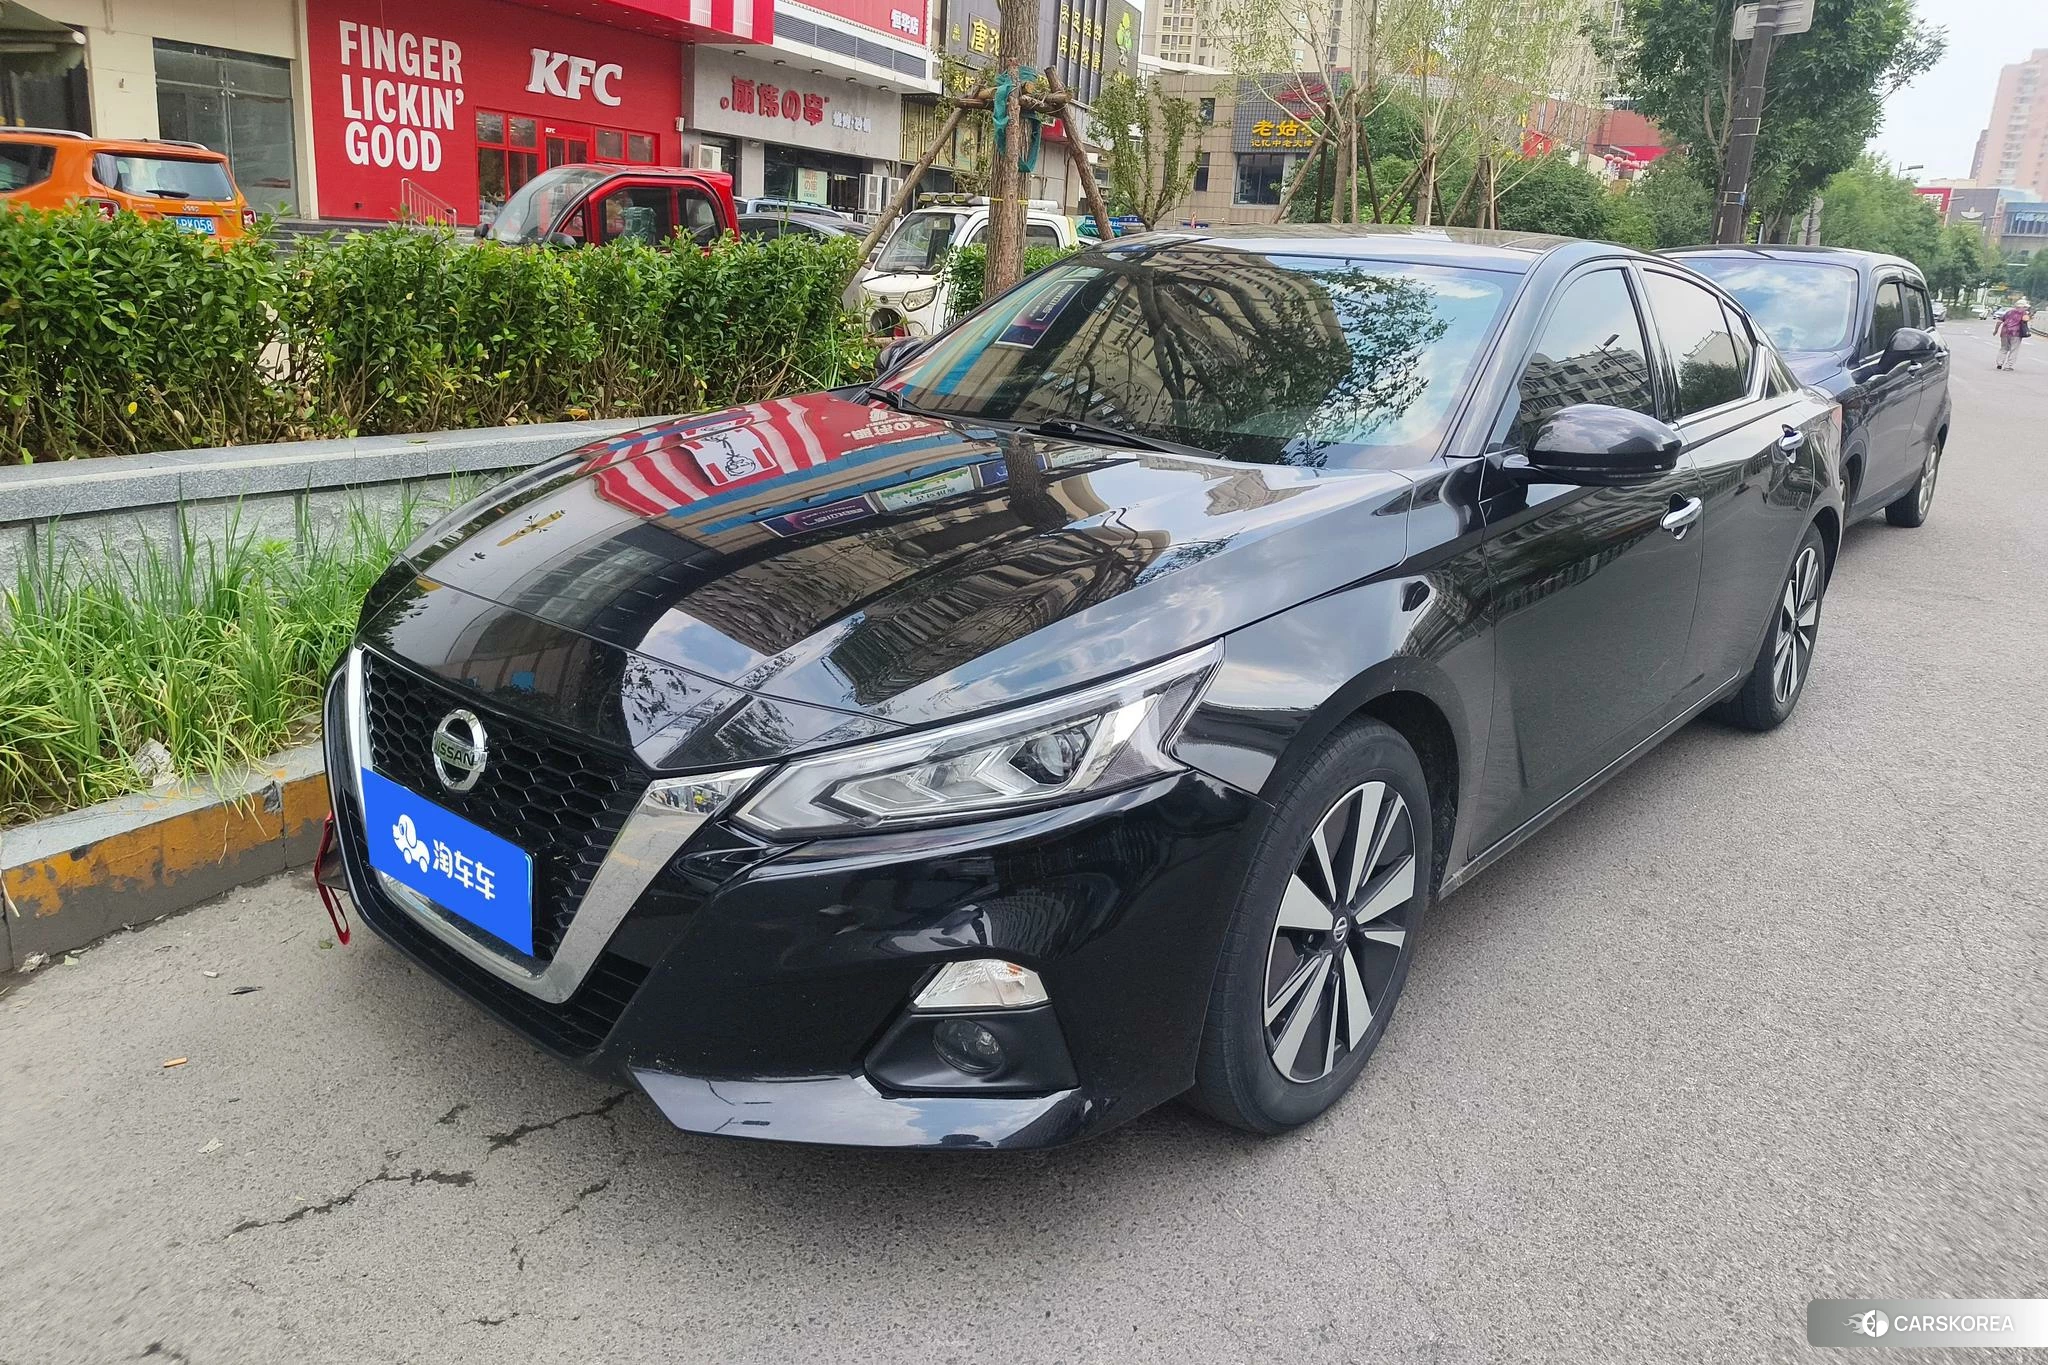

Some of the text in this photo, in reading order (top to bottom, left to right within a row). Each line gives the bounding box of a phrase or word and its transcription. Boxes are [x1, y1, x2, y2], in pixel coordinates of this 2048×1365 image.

[339, 19, 463, 84] FINGER
[525, 48, 622, 106] KFC
[341, 73, 464, 130] LICKIN'
[345, 121, 442, 172] GOOD
[436, 739, 475, 766] ISSAN
